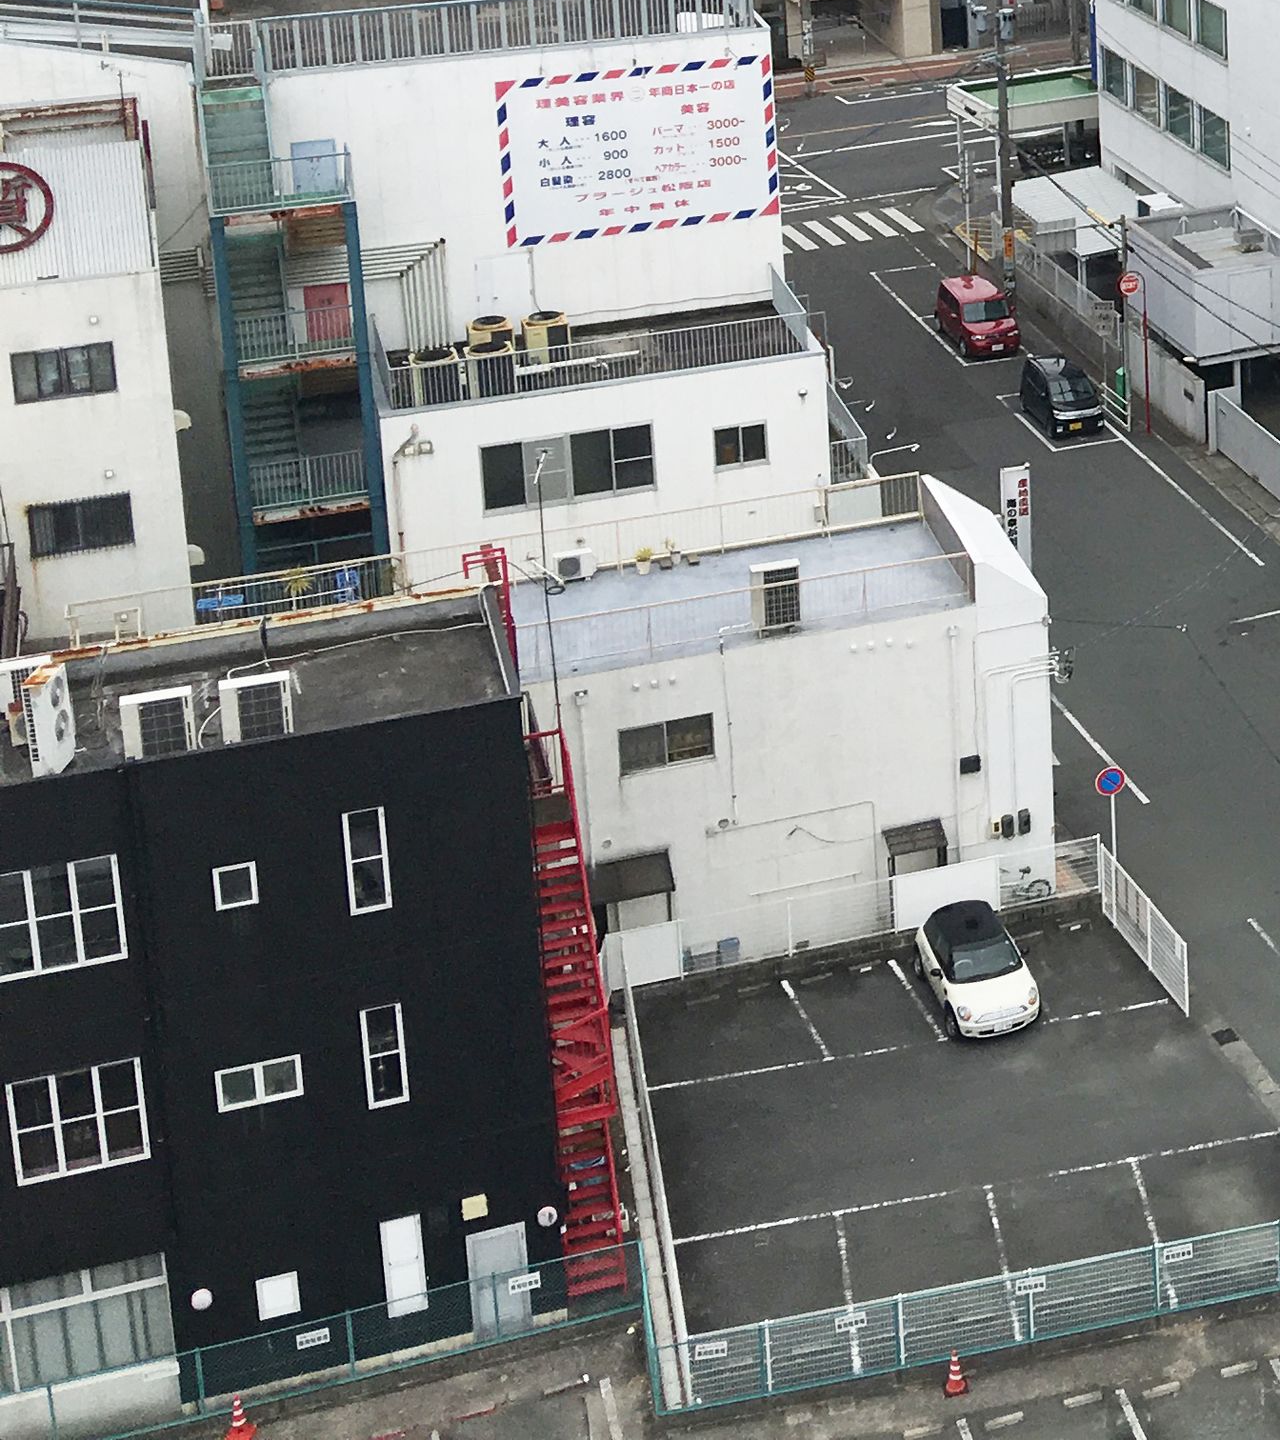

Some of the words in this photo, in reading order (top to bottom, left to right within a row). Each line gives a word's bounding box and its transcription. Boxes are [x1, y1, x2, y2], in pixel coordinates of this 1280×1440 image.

[680, 102, 710, 115] 美容
[565, 114, 596, 128] 理容
[594, 129, 628, 143] 1600
[708, 136, 740, 148] 1500
[603, 148, 629, 161] 900
[598, 168, 632, 182] 2800
[599, 198, 690, 217] 年中無休
